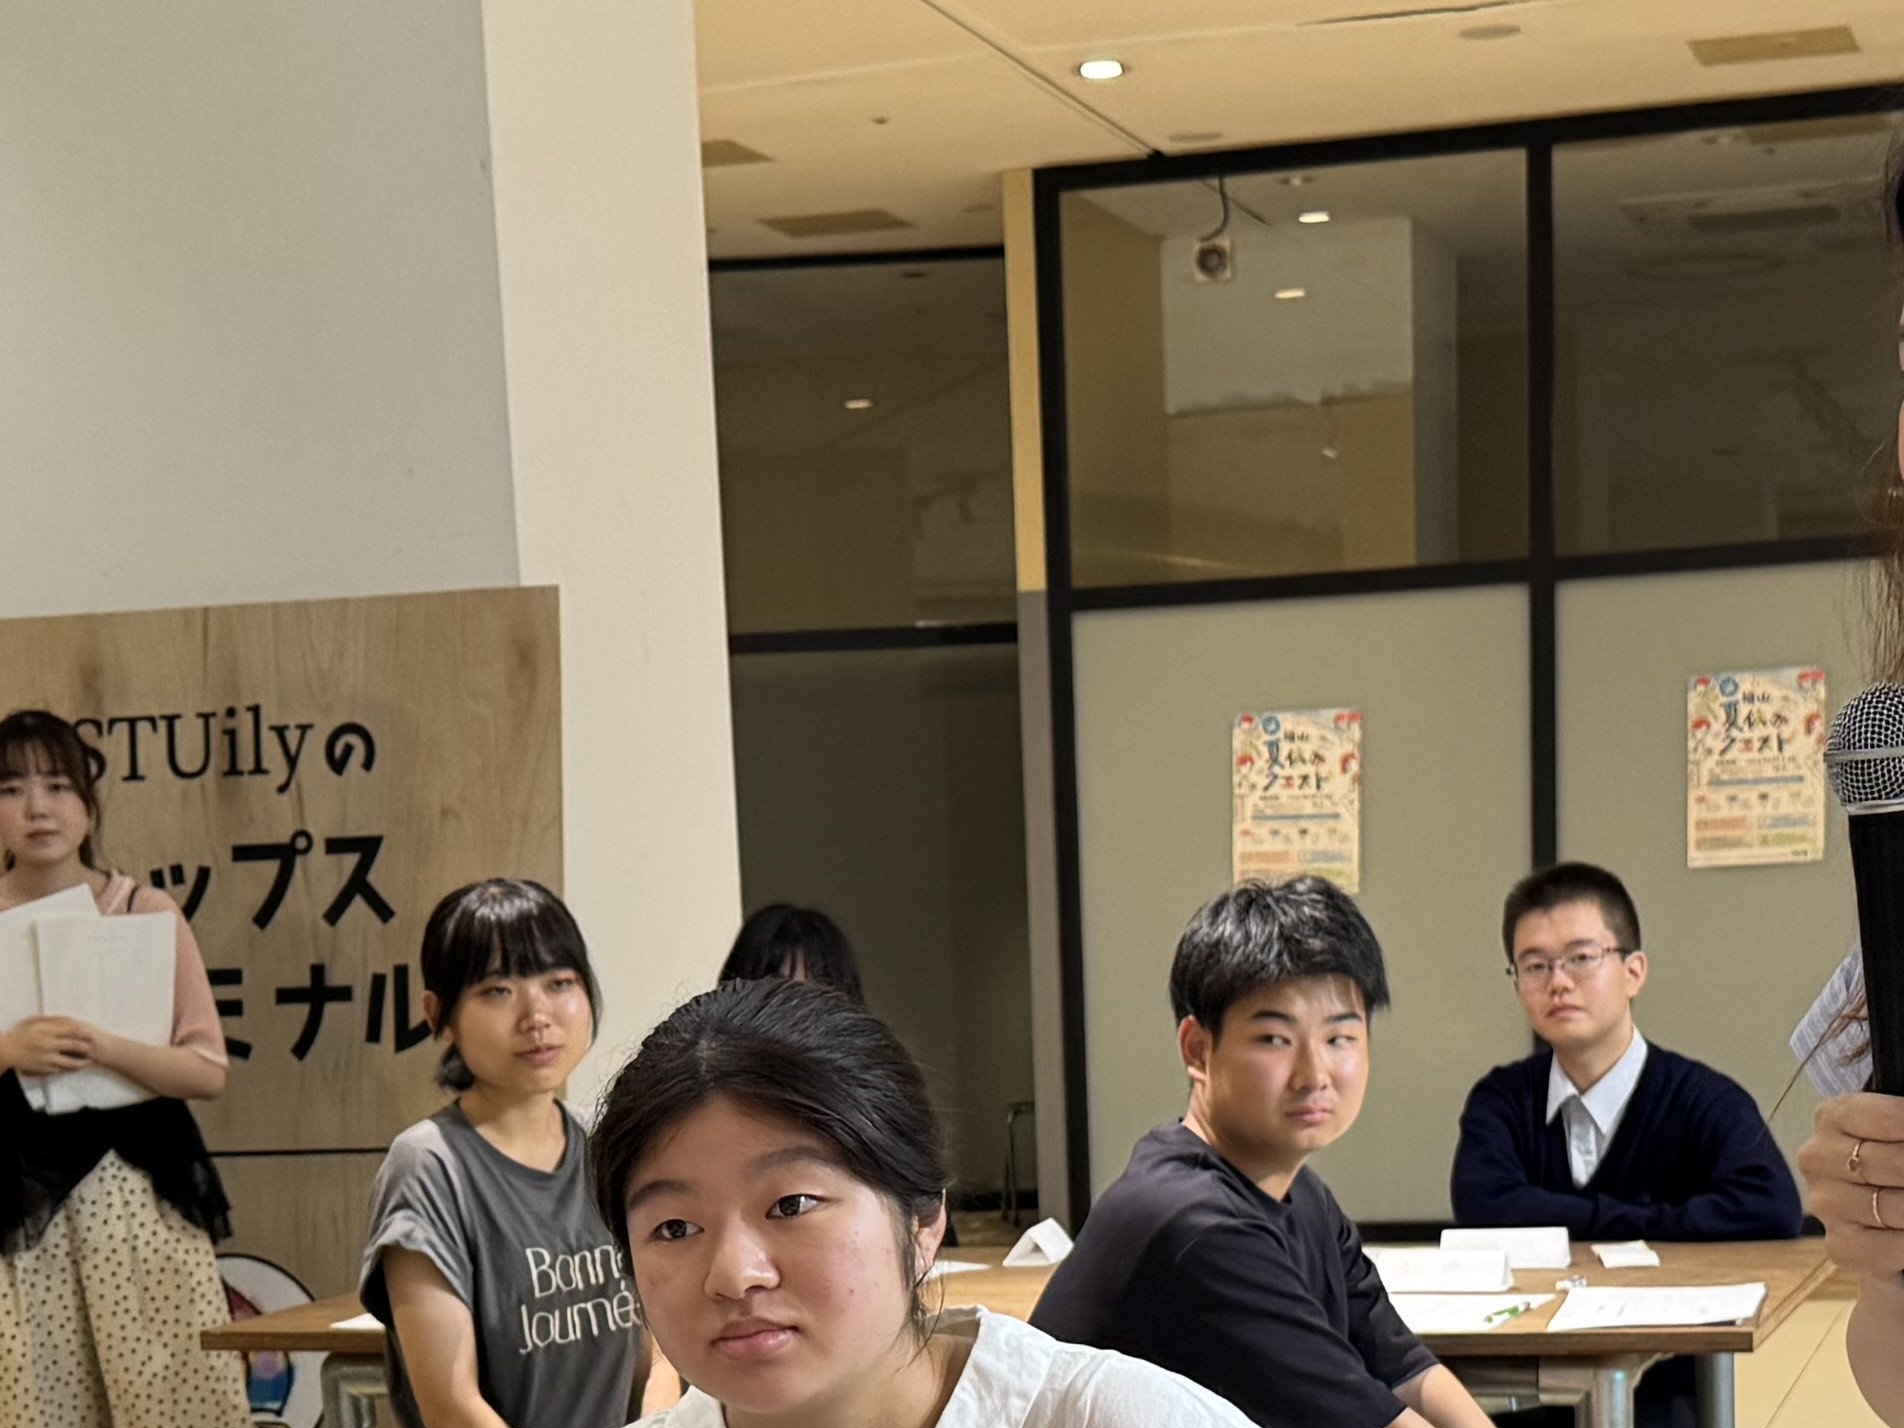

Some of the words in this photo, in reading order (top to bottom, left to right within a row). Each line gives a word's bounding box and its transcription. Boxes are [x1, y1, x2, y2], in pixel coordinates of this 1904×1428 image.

[150, 829, 395, 930] ップス
[207, 963, 433, 1061] ミナル
[526, 1245, 622, 1298] Bonn
[519, 1280, 642, 1355] Journé
